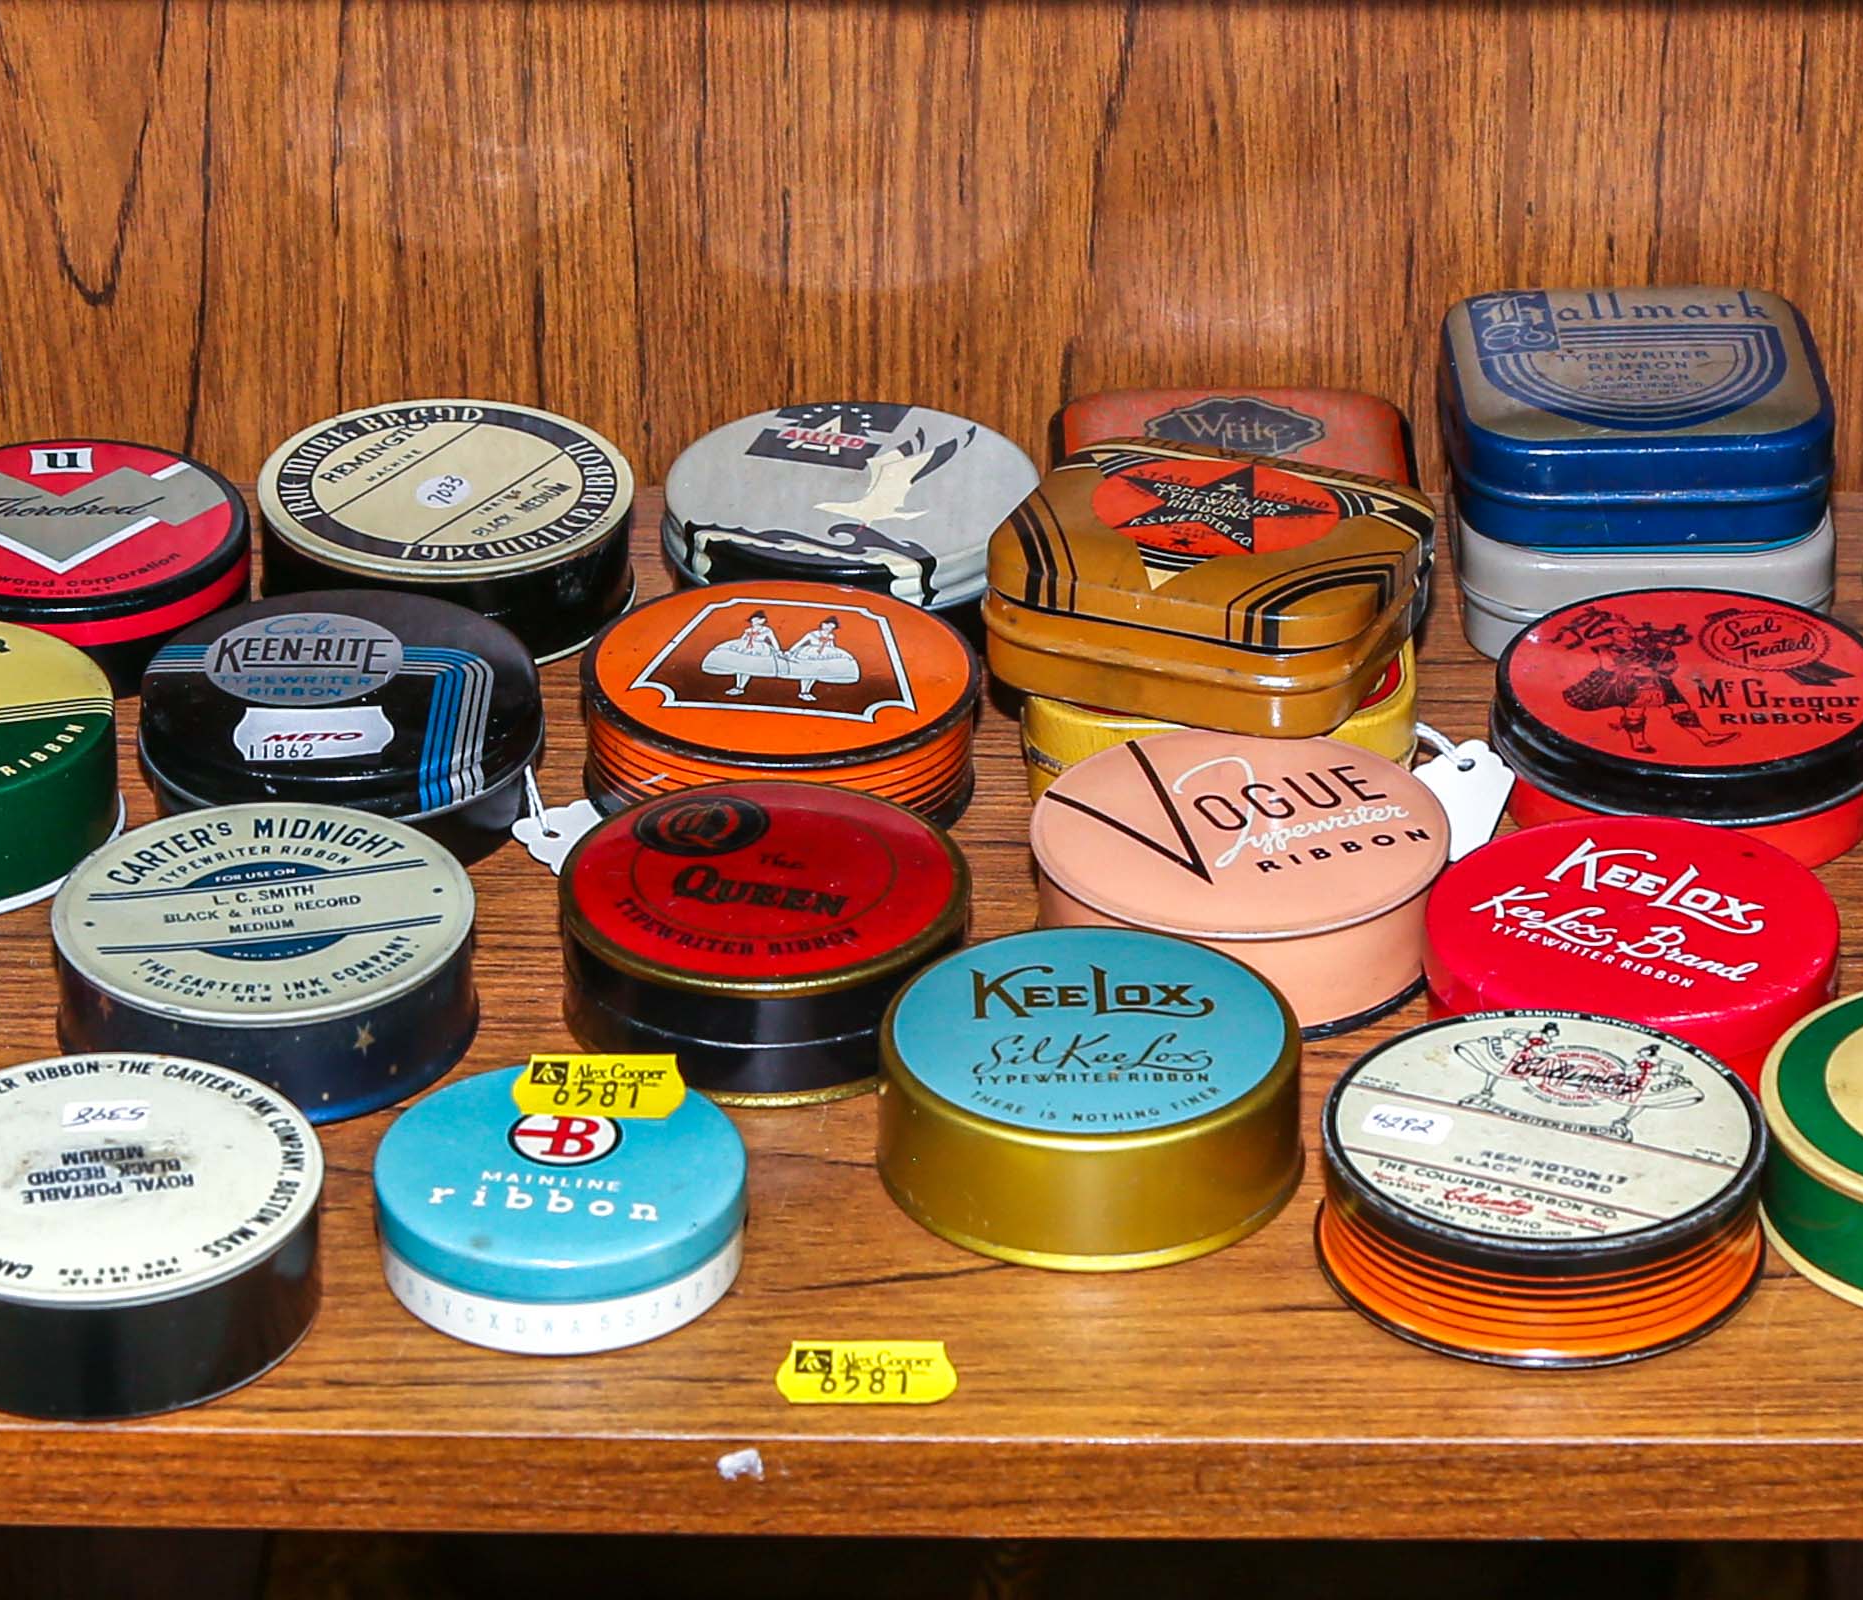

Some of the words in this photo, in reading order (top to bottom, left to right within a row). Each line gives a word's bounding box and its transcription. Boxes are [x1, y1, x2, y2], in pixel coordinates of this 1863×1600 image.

[778, 428, 866, 448] ALLIED
[366, 449, 422, 482] MACHINE
[1257, 490, 1329, 510] BRAND
[66, 552, 181, 588] corporation
[1723, 618, 1782, 648] Seal
[214, 638, 394, 673] KEEN-RITE
[1738, 637, 1816, 663] Treated
[219, 675, 372, 685] TYPEWRITER
[247, 688, 343, 697] RIBBON
[1719, 713, 1856, 725] RIBBONS
[249, 744, 313, 759] 11862
[264, 732, 364, 742] METO
[1044, 740, 1387, 885] VOGUE
[253, 817, 407, 858] MIDNIGHT
[1256, 829, 1431, 873] RIBBON
[158, 845, 272, 884] TYPEWRITER
[280, 844, 353, 865] RIBBON
[215, 874, 243, 883] FOR
[246, 871, 273, 881] USE
[276, 868, 296, 877] ON
[212, 895, 230, 906] L.
[235, 891, 250, 903] C.
[257, 885, 315, 900] SMITH
[672, 864, 850, 918] QUEEN
[163, 909, 220, 924] BLACK
[250, 904, 284, 916] RED
[294, 894, 361, 910] RECORD
[229, 919, 295, 934] MEDIUM
[615, 898, 754, 956] TYPEWRITER
[1470, 886, 1618, 947] KeeLox
[1616, 925, 1759, 983] Brand
[139, 958, 177, 978] THE
[283, 977, 324, 992] INK
[332, 935, 411, 981] COMPANY
[1491, 923, 1615, 964] TYPEWRITER
[1620, 959, 1696, 988] RIBBON
[144, 976, 206, 998] BOSTON
[235, 995, 272, 1003] NEW
[286, 988, 331, 1001] YORK
[356, 952, 415, 984] CHICAGO
[1464, 1011, 1505, 1021] NONE
[1514, 1010, 1581, 1019] GENUINE
[1590, 1014, 1661, 1039] WITHOUT
[1694, 1050, 1732, 1076] TWINS
[573, 1065, 608, 1082] Alex
[610, 1062, 668, 1088] Cooper
[976, 1072, 1119, 1084] TYPEWRITER
[1128, 1072, 1210, 1084] RIBBON
[162, 1064, 252, 1100] CARTER'S
[246, 1095, 279, 1124] INK
[553, 1081, 641, 1109] 6581
[970, 1090, 1025, 1116] THERE
[1039, 1110, 1057, 1120] IS
[1072, 1106, 1161, 1122] NOTHING
[1172, 1086, 1222, 1111] FINER
[1373, 1113, 1434, 1134] 4292
[61, 1145, 144, 1165] MEDIUM
[1481, 1151, 1605, 1181] REMINGTON
[27, 1166, 107, 1185] RECORD
[136, 1173, 194, 1192] ROYAL
[481, 1171, 623, 1193] MAINLINE
[1453, 1156, 1517, 1174] BLACK
[1531, 1172, 1612, 1194] RECORD
[22, 1180, 123, 1204] PORTABLE
[428, 1186, 660, 1221] ribbon
[1378, 1160, 1408, 1172] THE
[1414, 1167, 1502, 1193] COLUMBIA
[1511, 1189, 1583, 1212] CARBON
[1591, 1208, 1617, 1220] CO.
[1498, 1215, 1542, 1229] OHIO
[820, 1365, 907, 1394] 6581
